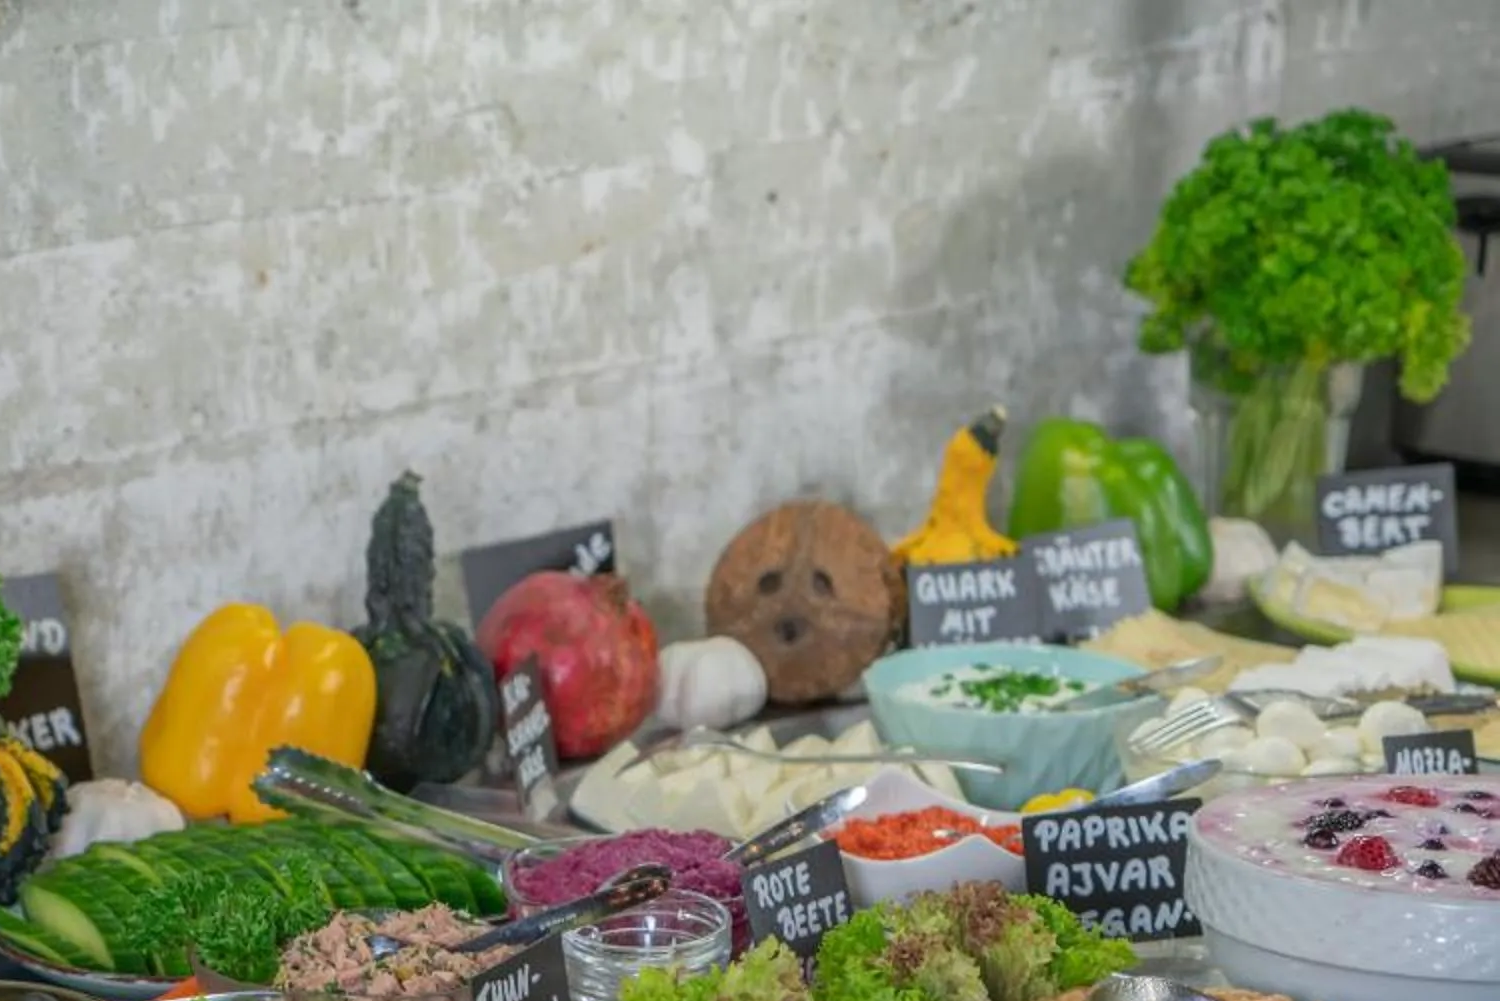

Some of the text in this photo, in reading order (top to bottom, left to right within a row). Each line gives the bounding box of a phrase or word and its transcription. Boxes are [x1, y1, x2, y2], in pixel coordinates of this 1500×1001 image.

[917, 568, 1016, 604] QUARK
[940, 606, 996, 636] MIT
[1033, 810, 1192, 852] PAPRIKA
[753, 861, 811, 909] ROTE
[1046, 855, 1175, 896] AJVAR
[777, 890, 849, 942] BEETE
